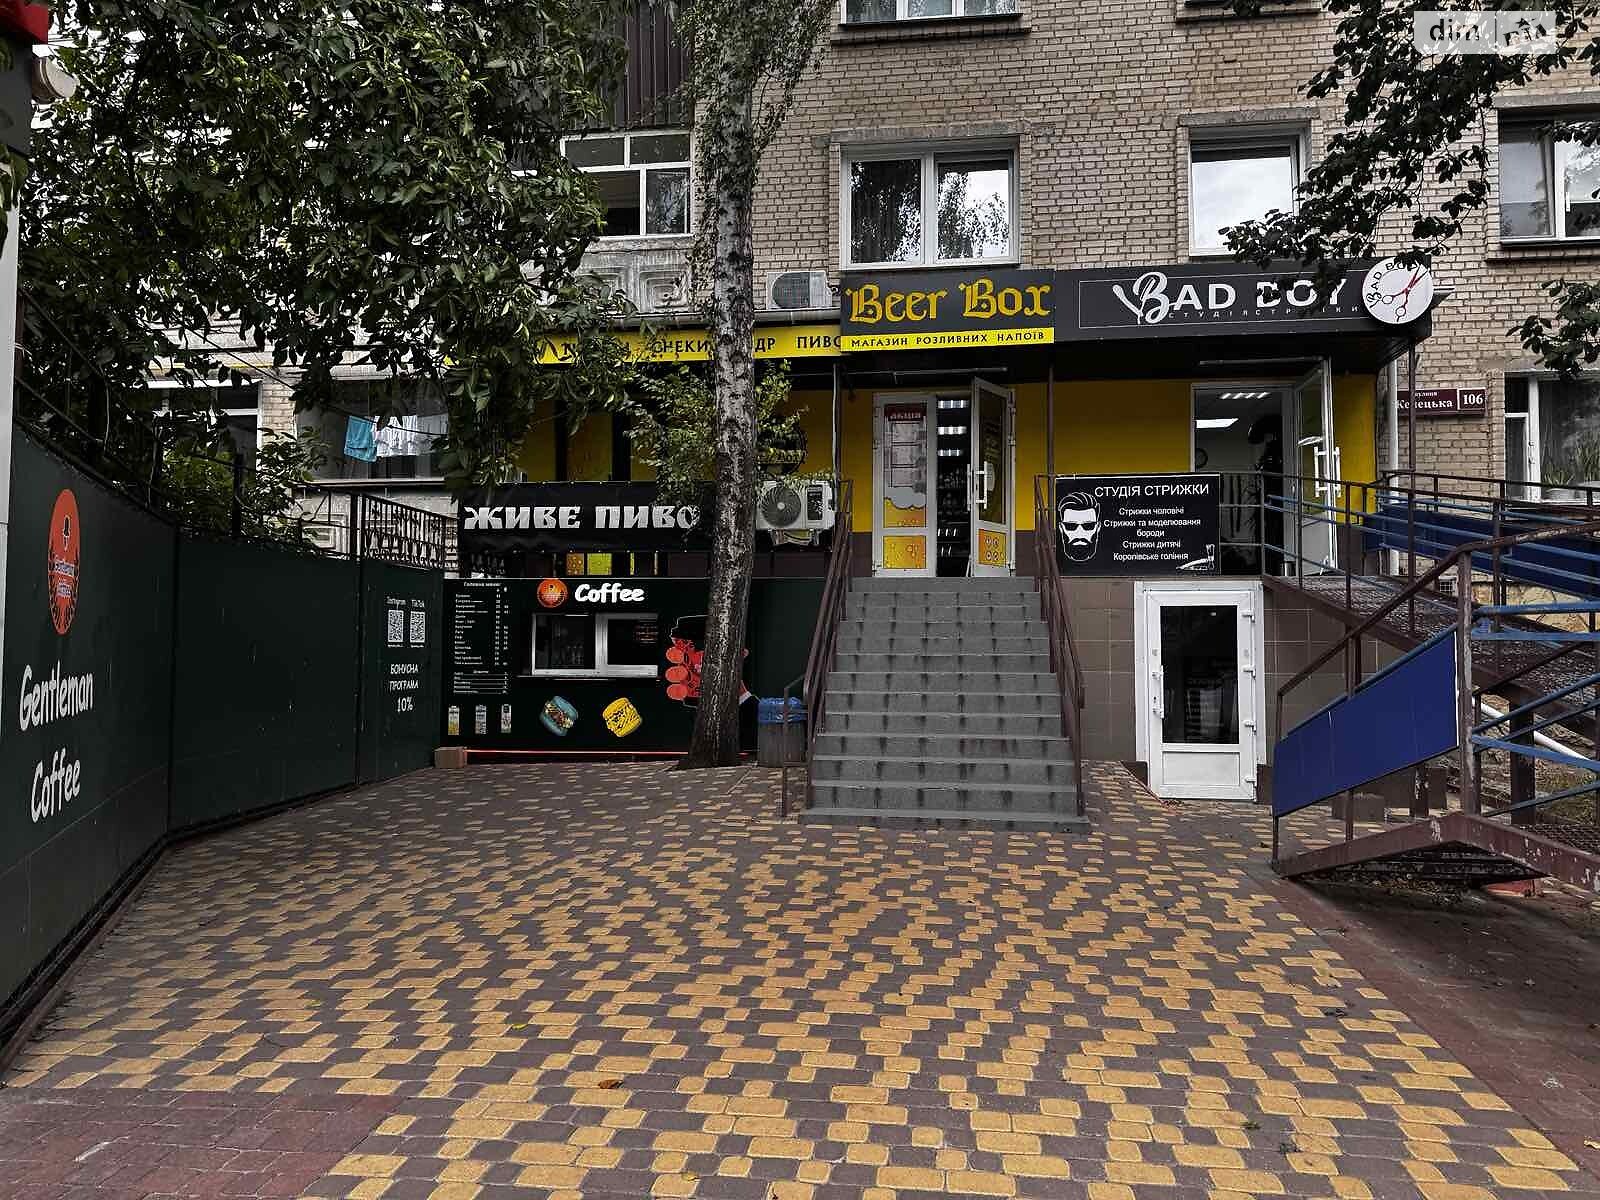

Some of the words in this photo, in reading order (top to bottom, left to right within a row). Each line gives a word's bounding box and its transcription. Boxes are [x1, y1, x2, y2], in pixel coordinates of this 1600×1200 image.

[845, 283, 949, 324] Beer
[958, 277, 1051, 319] Box
[1112, 271, 1237, 325] BAD
[851, 337, 909, 348] МАГАЗИН
[916, 333, 988, 345] РОЗЛИВНИХ
[997, 330, 1045, 342] НАПОЇВ
[1463, 393, 1483, 405] 106
[1094, 485, 1141, 499] СТУДІЯ
[1144, 483, 1210, 497] СТРИЖКИ
[463, 505, 581, 530] ЖИВЕ
[595, 504, 700, 530] ПИВО
[1118, 507, 1151, 516] Стрижки
[1152, 506, 1184, 515] чоловічі
[1103, 519, 1136, 528] Стрижки
[1148, 518, 1201, 528] моделювання
[1136, 528, 1165, 538] бороди
[1122, 540, 1155, 550] Стрижки
[1156, 540, 1181, 549] дитячі
[1113, 552, 1159, 561] Королівське
[1160, 551, 1189, 560] гоління
[574, 583, 646, 604] Coffee
[390, 663, 419, 675] БОНУСНА
[389, 680, 419, 693] ПРОГРАМА
[19, 659, 94, 731] Gentleman
[397, 696, 414, 713] 10%
[31, 747, 81, 823] Coffee
